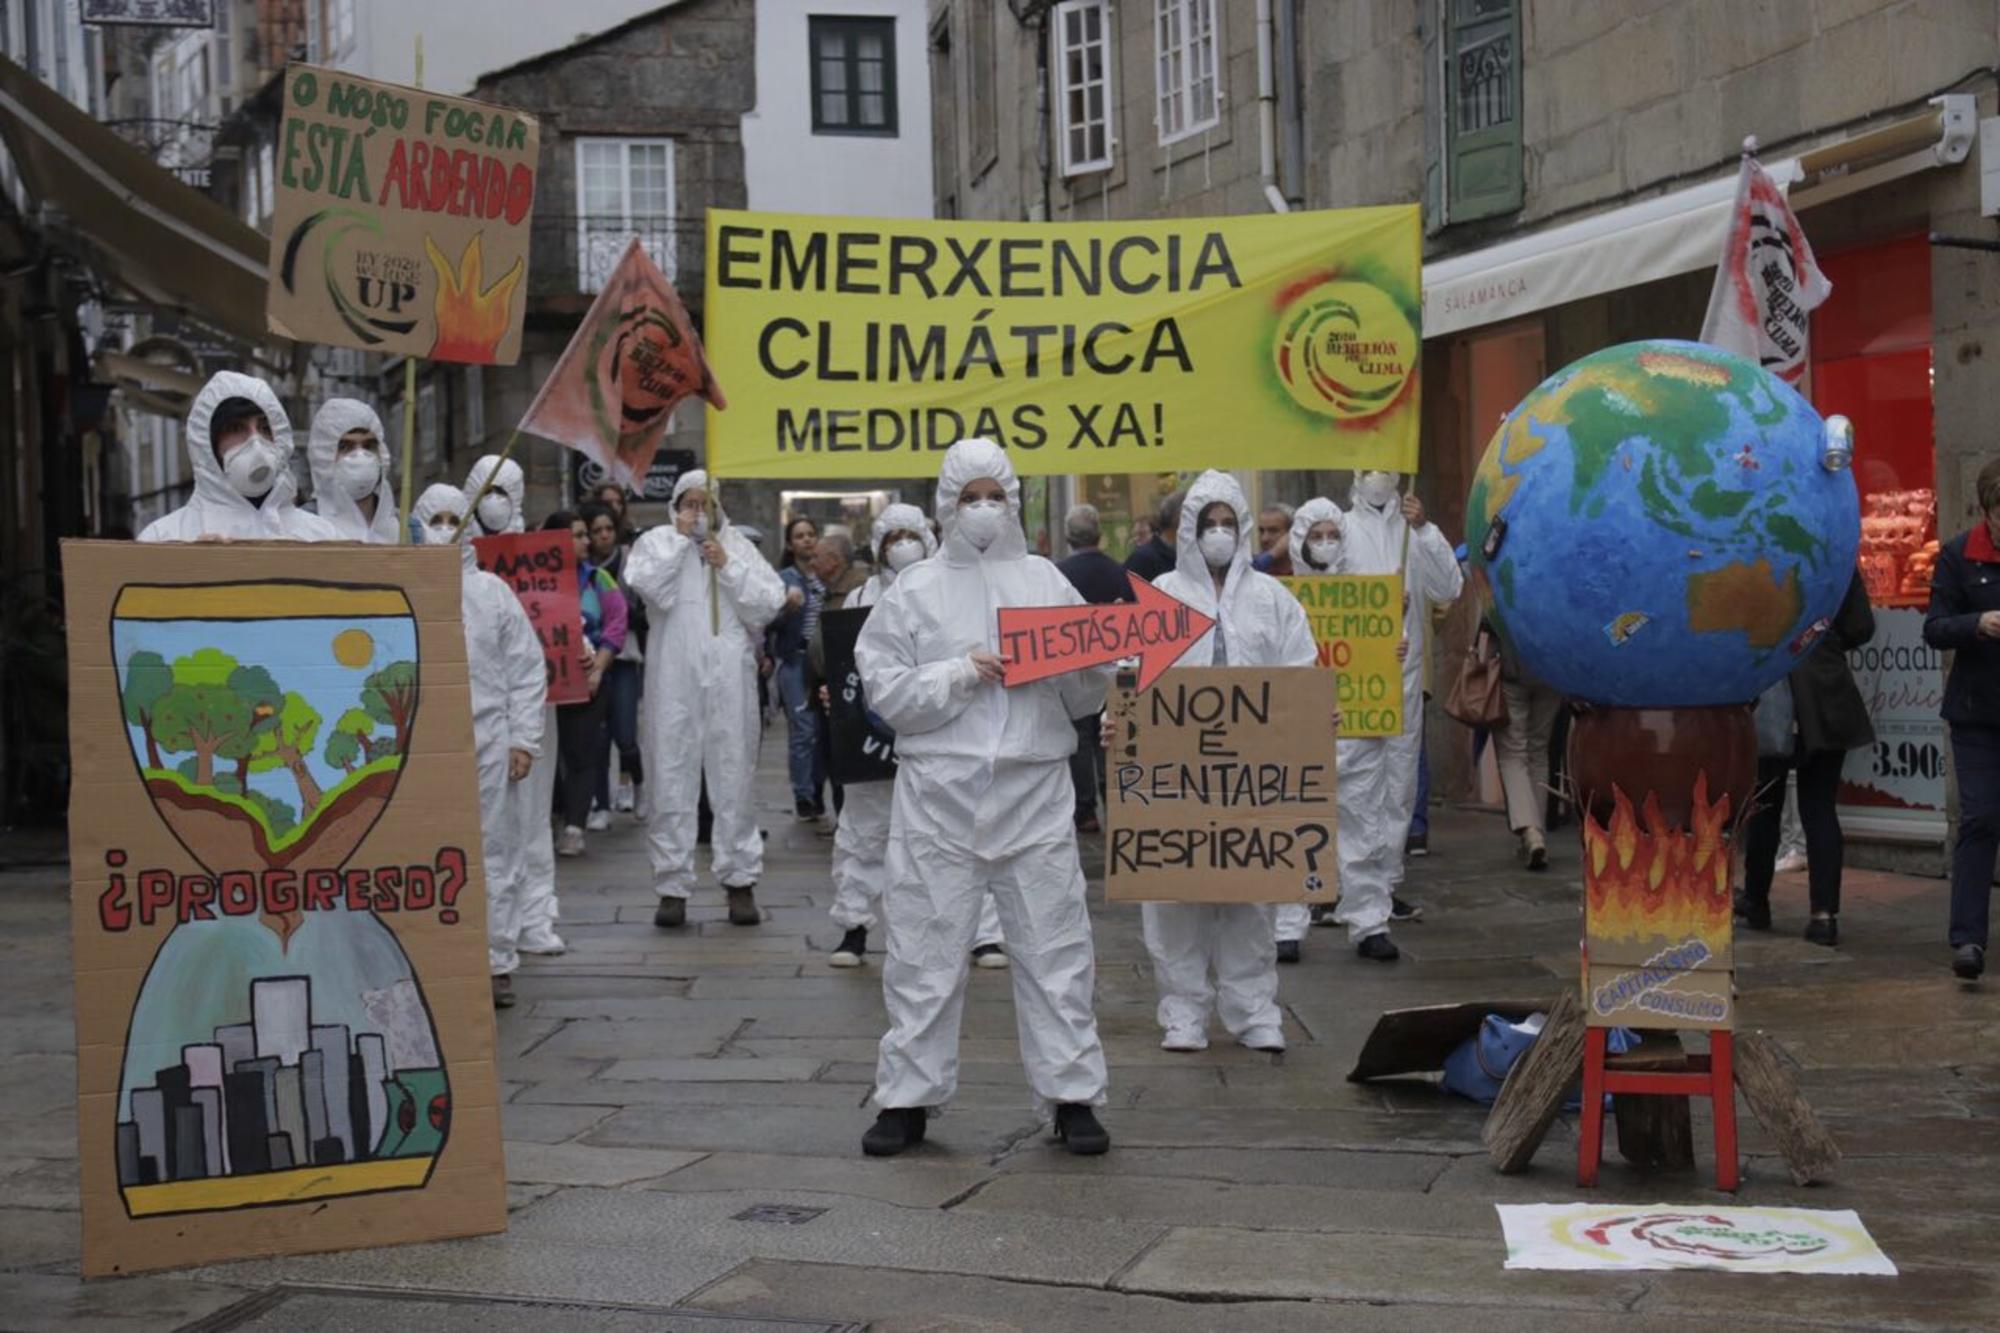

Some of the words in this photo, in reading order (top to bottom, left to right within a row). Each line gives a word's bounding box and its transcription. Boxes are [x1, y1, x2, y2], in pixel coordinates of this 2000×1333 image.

[292, 73, 317, 106] O
[328, 82, 408, 129] NOSO
[425, 101, 527, 150] FOGAR
[282, 118, 377, 202] ESTÁ
[379, 138, 533, 225] ARDENDO
[718, 225, 1243, 299] EMERXENCIA
[357, 276, 416, 313] UP
[758, 309, 1193, 382] CLIMÁTICA
[1359, 362, 1403, 375] CLIMA
[777, 403, 1048, 452] MEDIDAS
[1068, 403, 1164, 449] XA!
[477, 546, 564, 577] AMOS
[1042, 610, 1121, 658] ESTÁS
[1315, 640, 1352, 668] NO
[1151, 681, 1270, 727] NON
[1199, 721, 1238, 757] É
[1118, 763, 1328, 808] RENTABLE
[99, 847, 468, 932] ¿PROGRESO?
